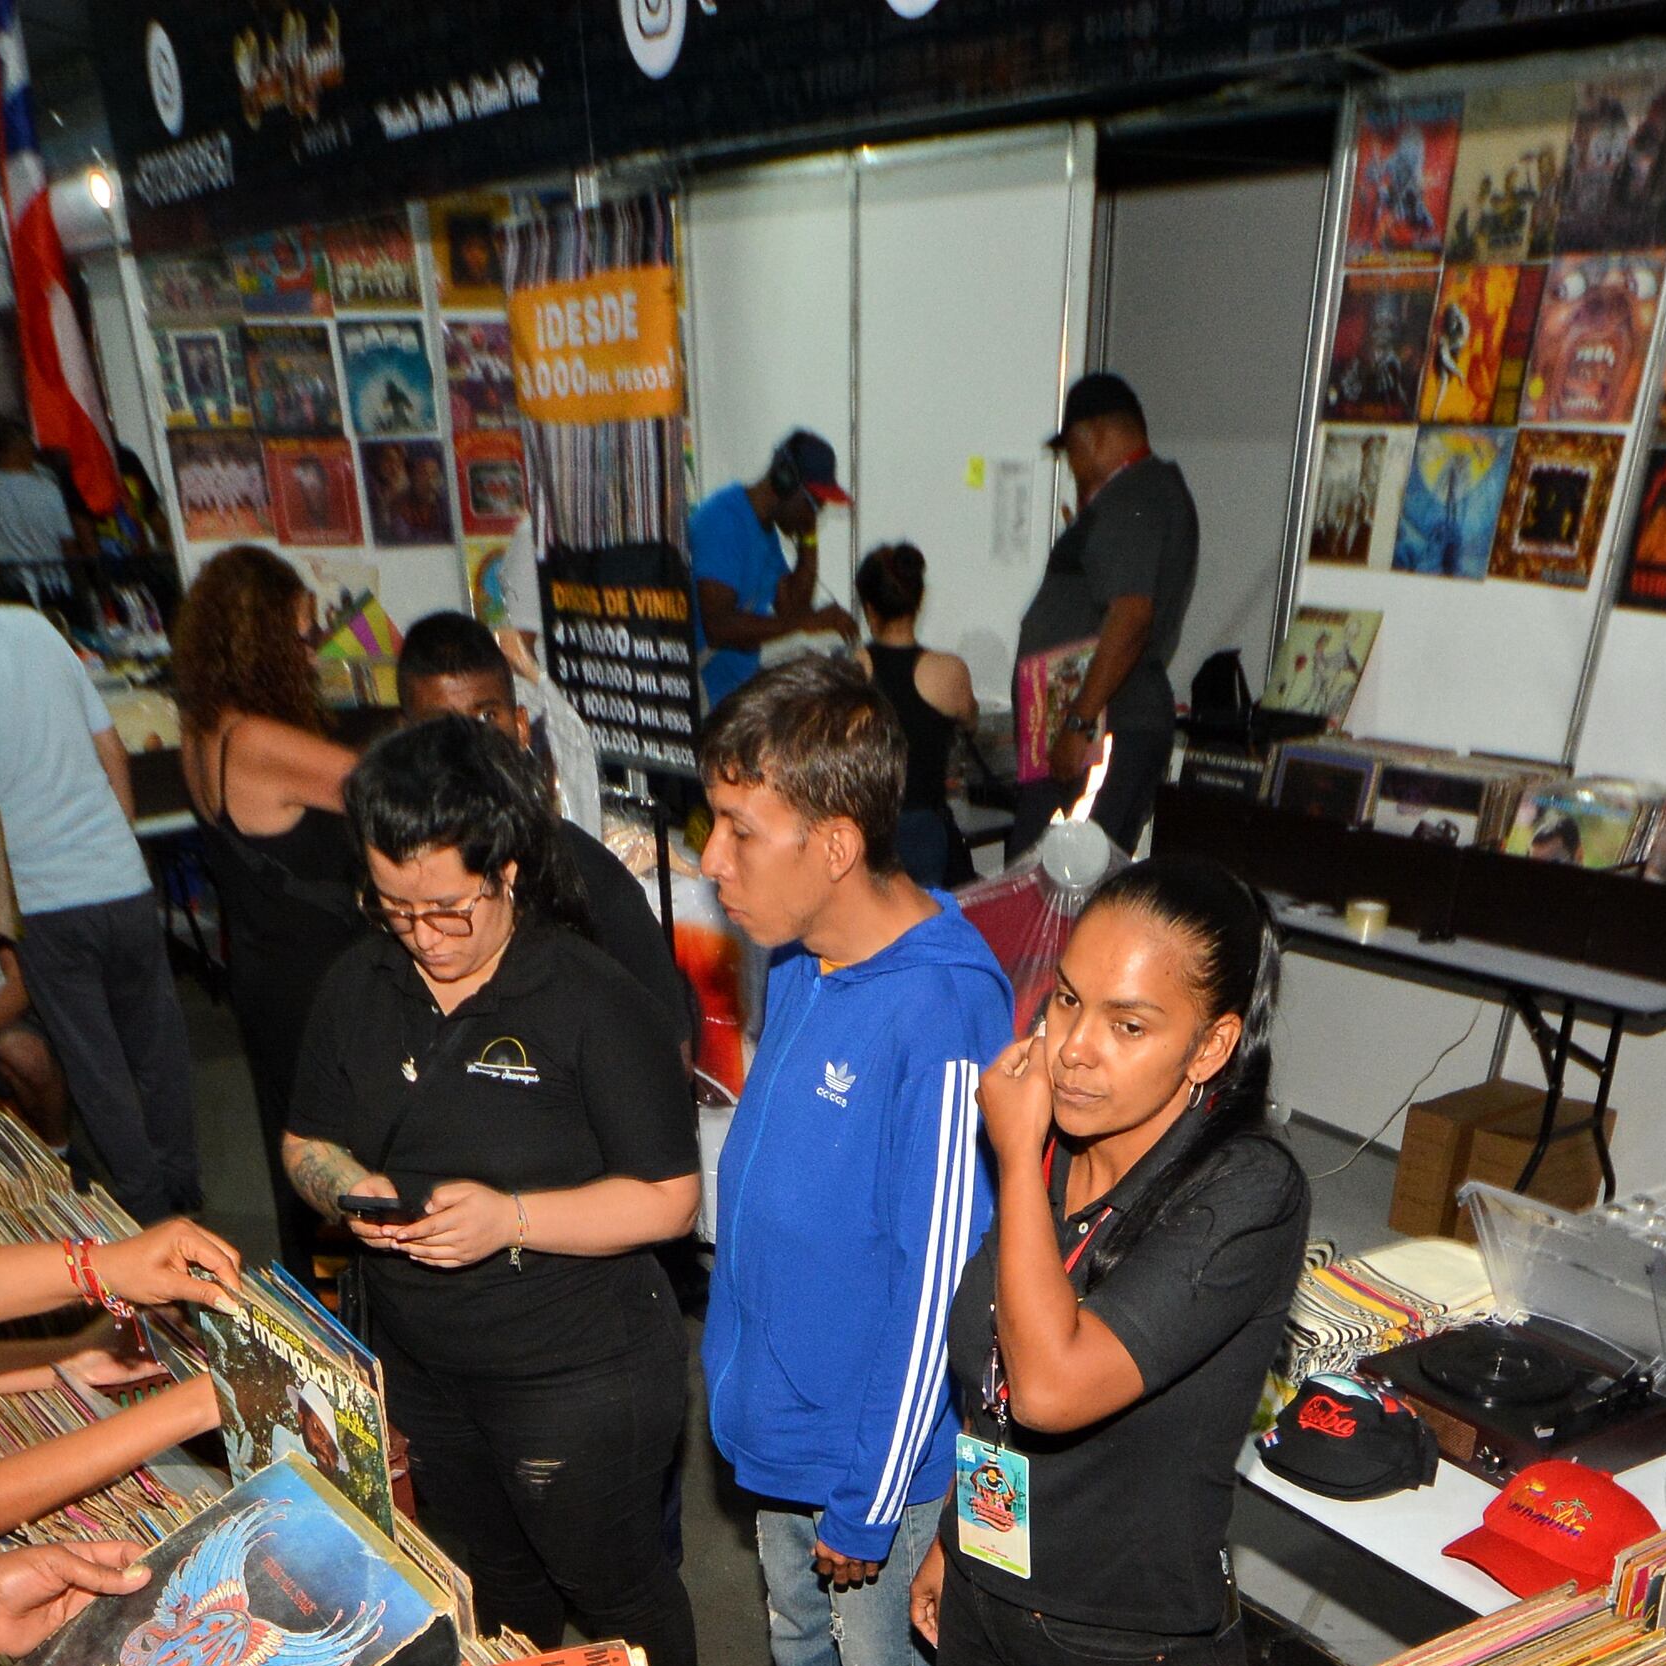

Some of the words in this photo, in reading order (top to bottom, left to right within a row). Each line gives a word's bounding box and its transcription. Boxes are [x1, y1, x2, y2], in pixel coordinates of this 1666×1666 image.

[602, 585, 630, 617] DE
[632, 588, 689, 622] VINILO
[634, 636, 658, 661] MIL
[658, 638, 689, 664] PESOS
[635, 671, 660, 695] MIL
[661, 671, 690, 699] PESOS
[639, 704, 660, 727] MIL
[662, 706, 692, 735] PESOS
[589, 722, 639, 756] 00.000
[662, 740, 696, 769] PESOS
[816, 1085, 849, 1109] adidas
[252, 1305, 271, 1328] QUE
[253, 1320, 335, 1397] mangual
[1297, 1395, 1359, 1439] Cuba
